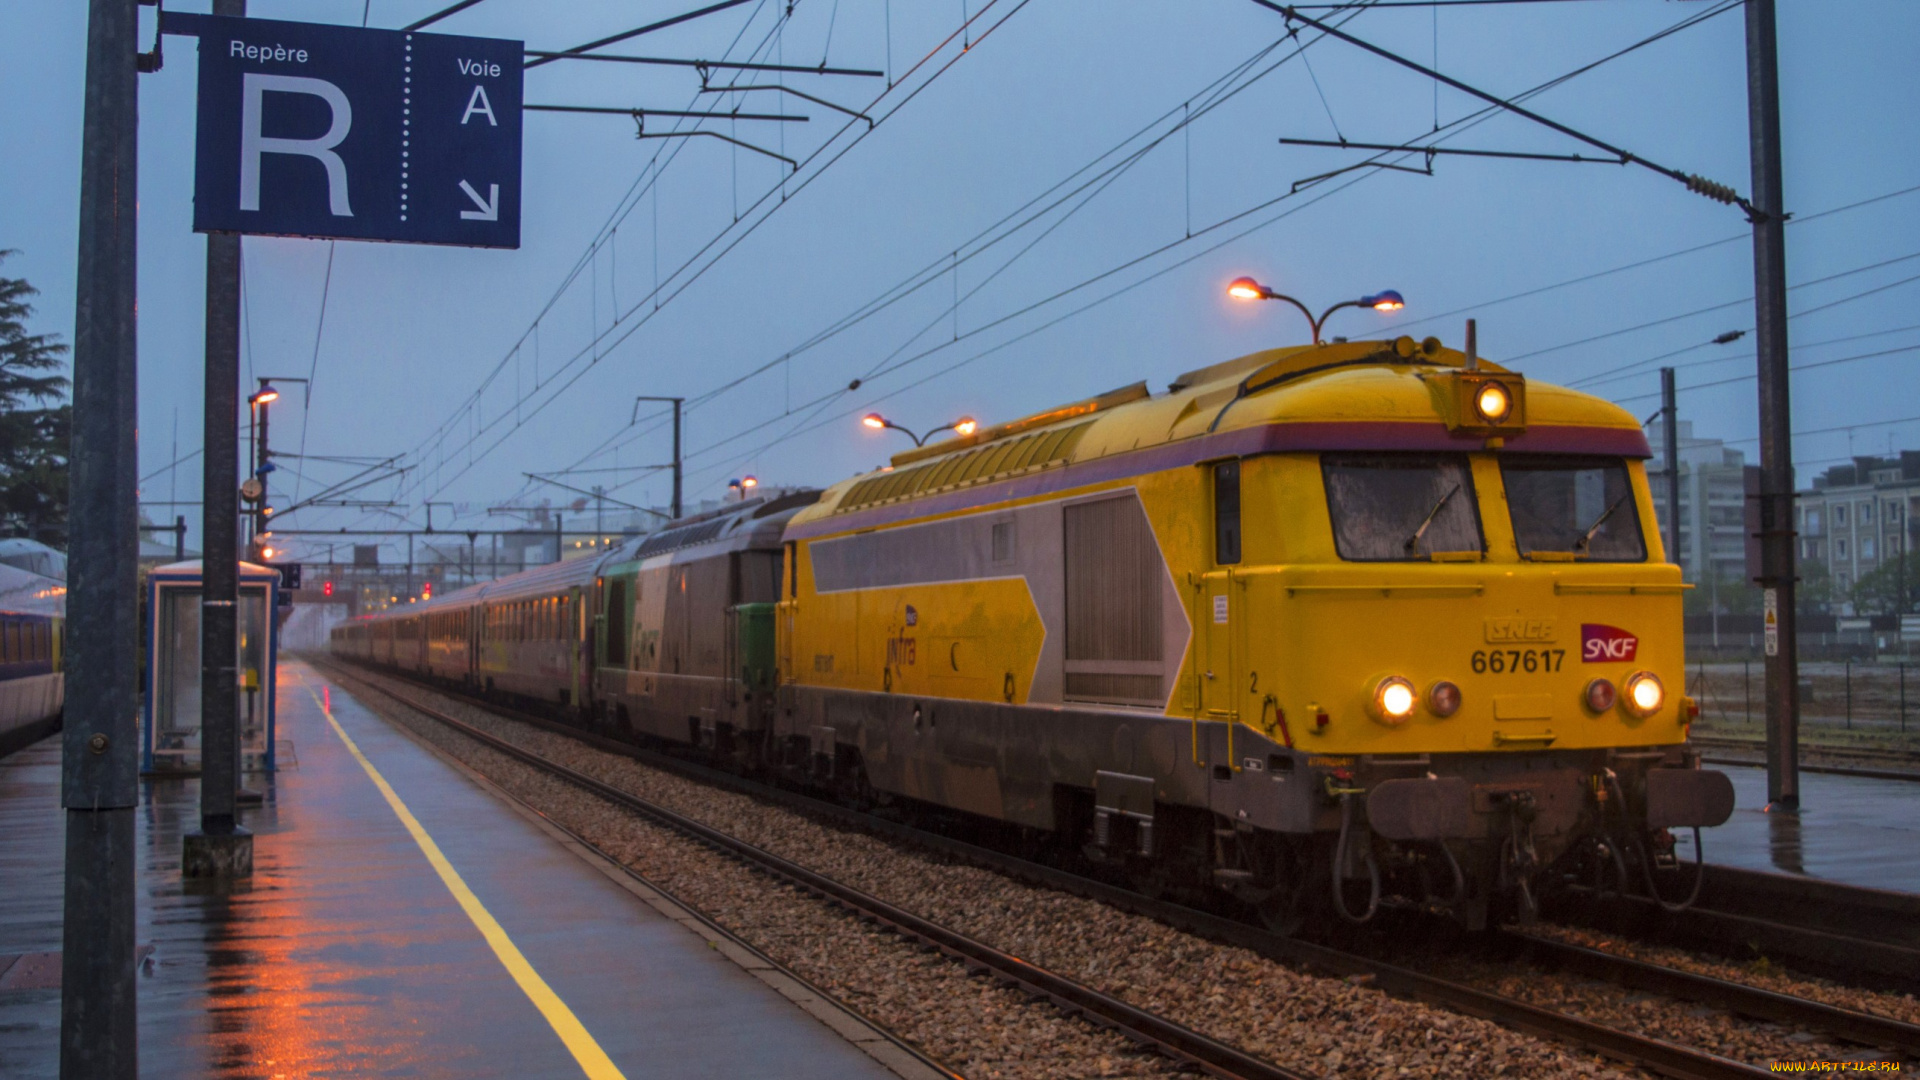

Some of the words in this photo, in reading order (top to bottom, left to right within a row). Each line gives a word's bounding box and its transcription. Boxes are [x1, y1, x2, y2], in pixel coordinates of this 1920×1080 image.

[230, 40, 309, 63] Repère
[457, 58, 501, 77] Voie
[461, 85, 498, 126] A
[239, 72, 355, 217] R
[1584, 638, 1636, 659] SNCF
[1471, 649, 1566, 674] 667617
[1250, 670, 1258, 694] 2
